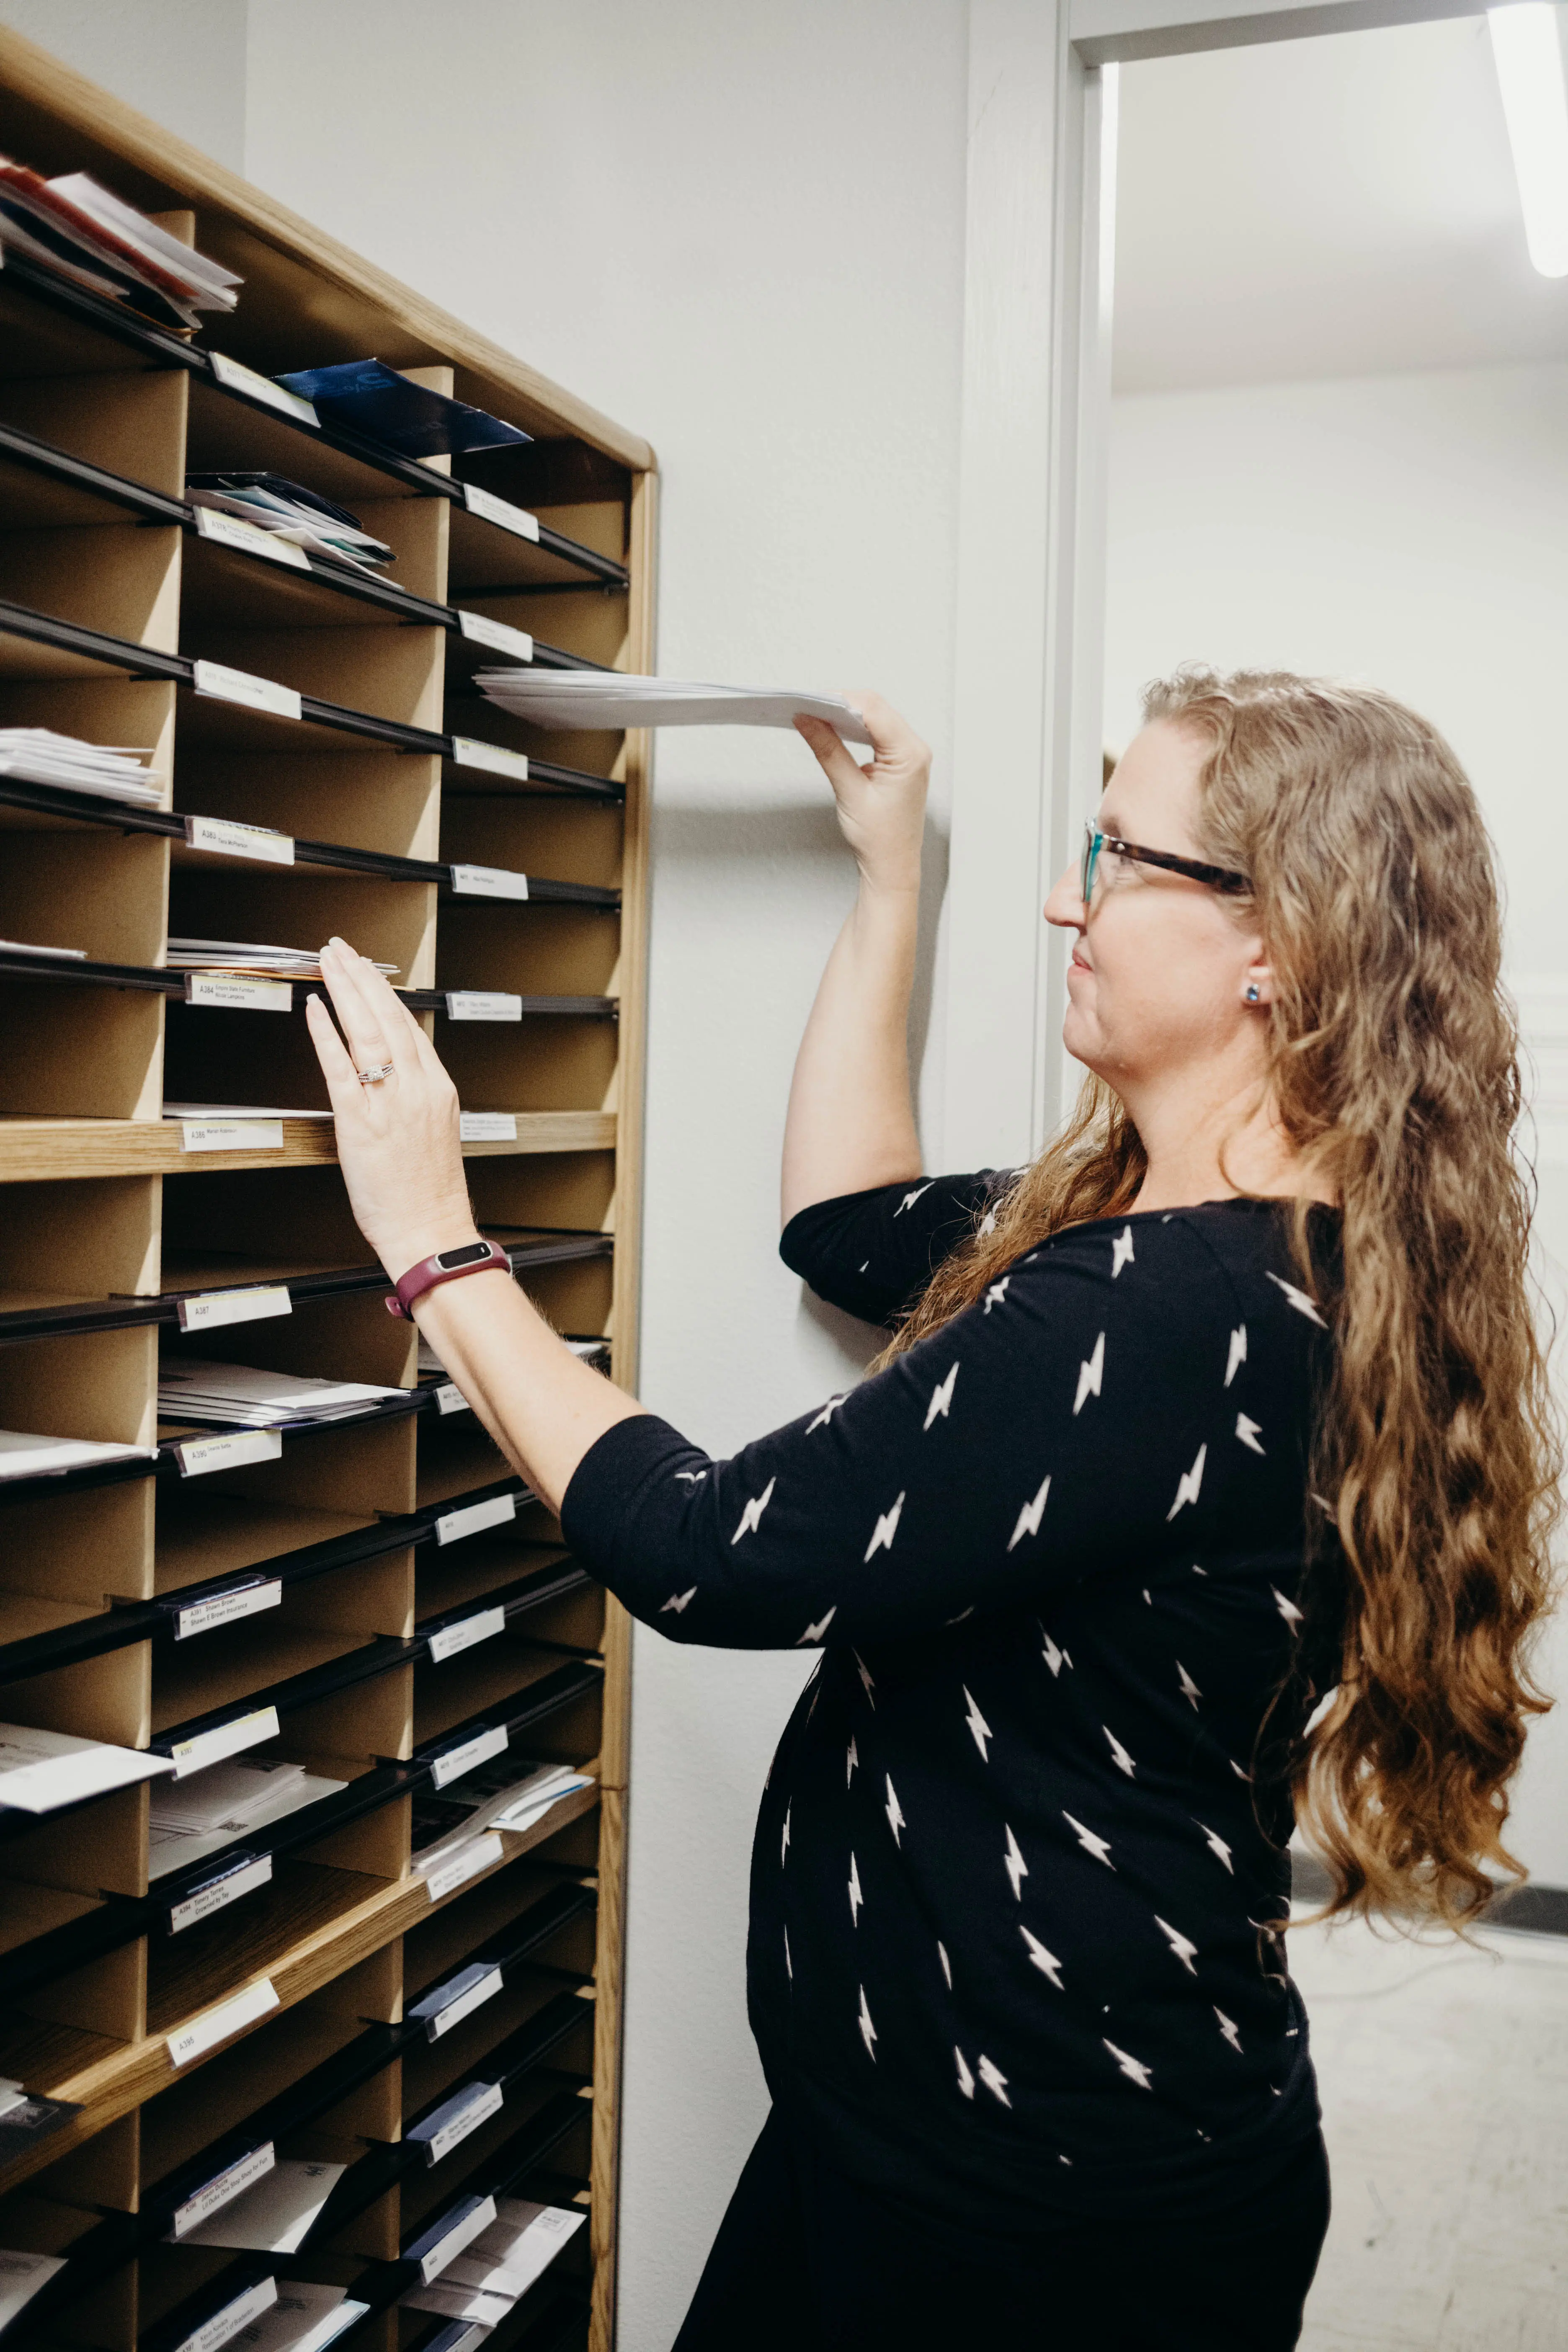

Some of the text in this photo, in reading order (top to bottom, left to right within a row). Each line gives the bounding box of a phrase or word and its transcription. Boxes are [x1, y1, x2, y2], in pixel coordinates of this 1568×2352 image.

[196, 1306, 209, 1315] A387
[206, 1603, 221, 1612] Shawn
[222, 1597, 236, 1607] Brown
[191, 1616, 206, 1626] Shawn
[211, 1611, 225, 1620] Brown
[227, 1602, 248, 1615] Insurance
[210, 1886, 224, 1897] Torres
[195, 1901, 215, 1915] Crowned
[179, 2036, 195, 2051] A395
[209, 2194, 220, 2205] Duke
[221, 2187, 230, 2197] One
[230, 2179, 240, 2190] Stop
[241, 2169, 252, 2181] Shop
[259, 2156, 268, 2166] Fun
[201, 2189, 214, 2202] Jason
